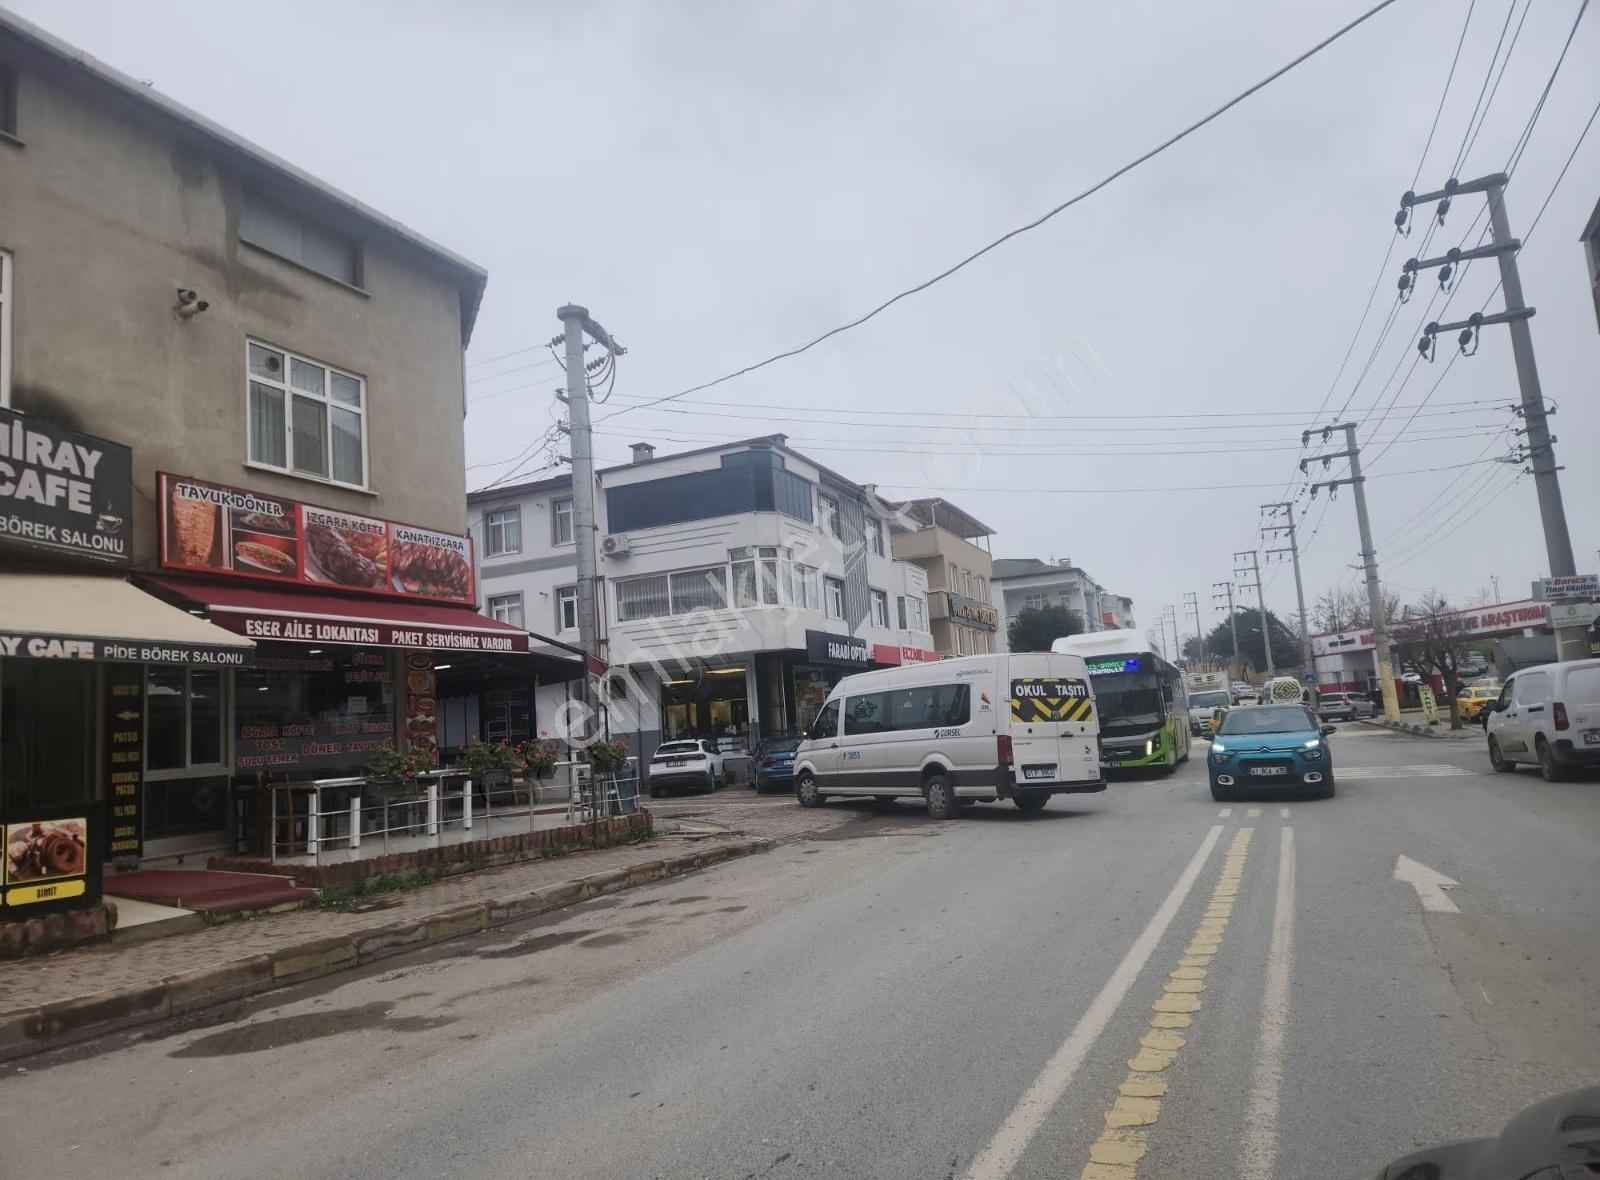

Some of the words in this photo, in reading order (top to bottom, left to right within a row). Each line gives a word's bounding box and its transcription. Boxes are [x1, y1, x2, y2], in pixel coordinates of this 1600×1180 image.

[0, 461, 92, 514] CAFE
[177, 484, 233, 506] TAVUK
[235, 494, 283, 516] DÖNER
[352, 519, 384, 535] KÖFTE
[61, 528, 124, 553] SALONU
[396, 529, 429, 544] KANAT
[431, 535, 464, 551] IZGARA
[246, 619, 280, 637] ESER
[284, 619, 313, 638] AİLE
[316, 625, 379, 643] LOKANTASI
[391, 629, 423, 645] PAKET
[426, 632, 480, 649] SERVİSİMİZ
[481, 636, 512, 651] VARDIR
[27, 638, 95, 659] CAFE
[104, 645, 137, 660] PİDE
[141, 646, 189, 662] BÖREK
[192, 651, 243, 665] SALONU
[828, 641, 850, 660] FARABİ
[851, 643, 867, 662] OPTİK
[1015, 685, 1047, 696] OKUL
[1055, 685, 1086, 697] TAŞITI
[256, 740, 284, 750] TOST
[303, 743, 341, 755] DÖNER
[36, 886, 57, 898] SİMİT
